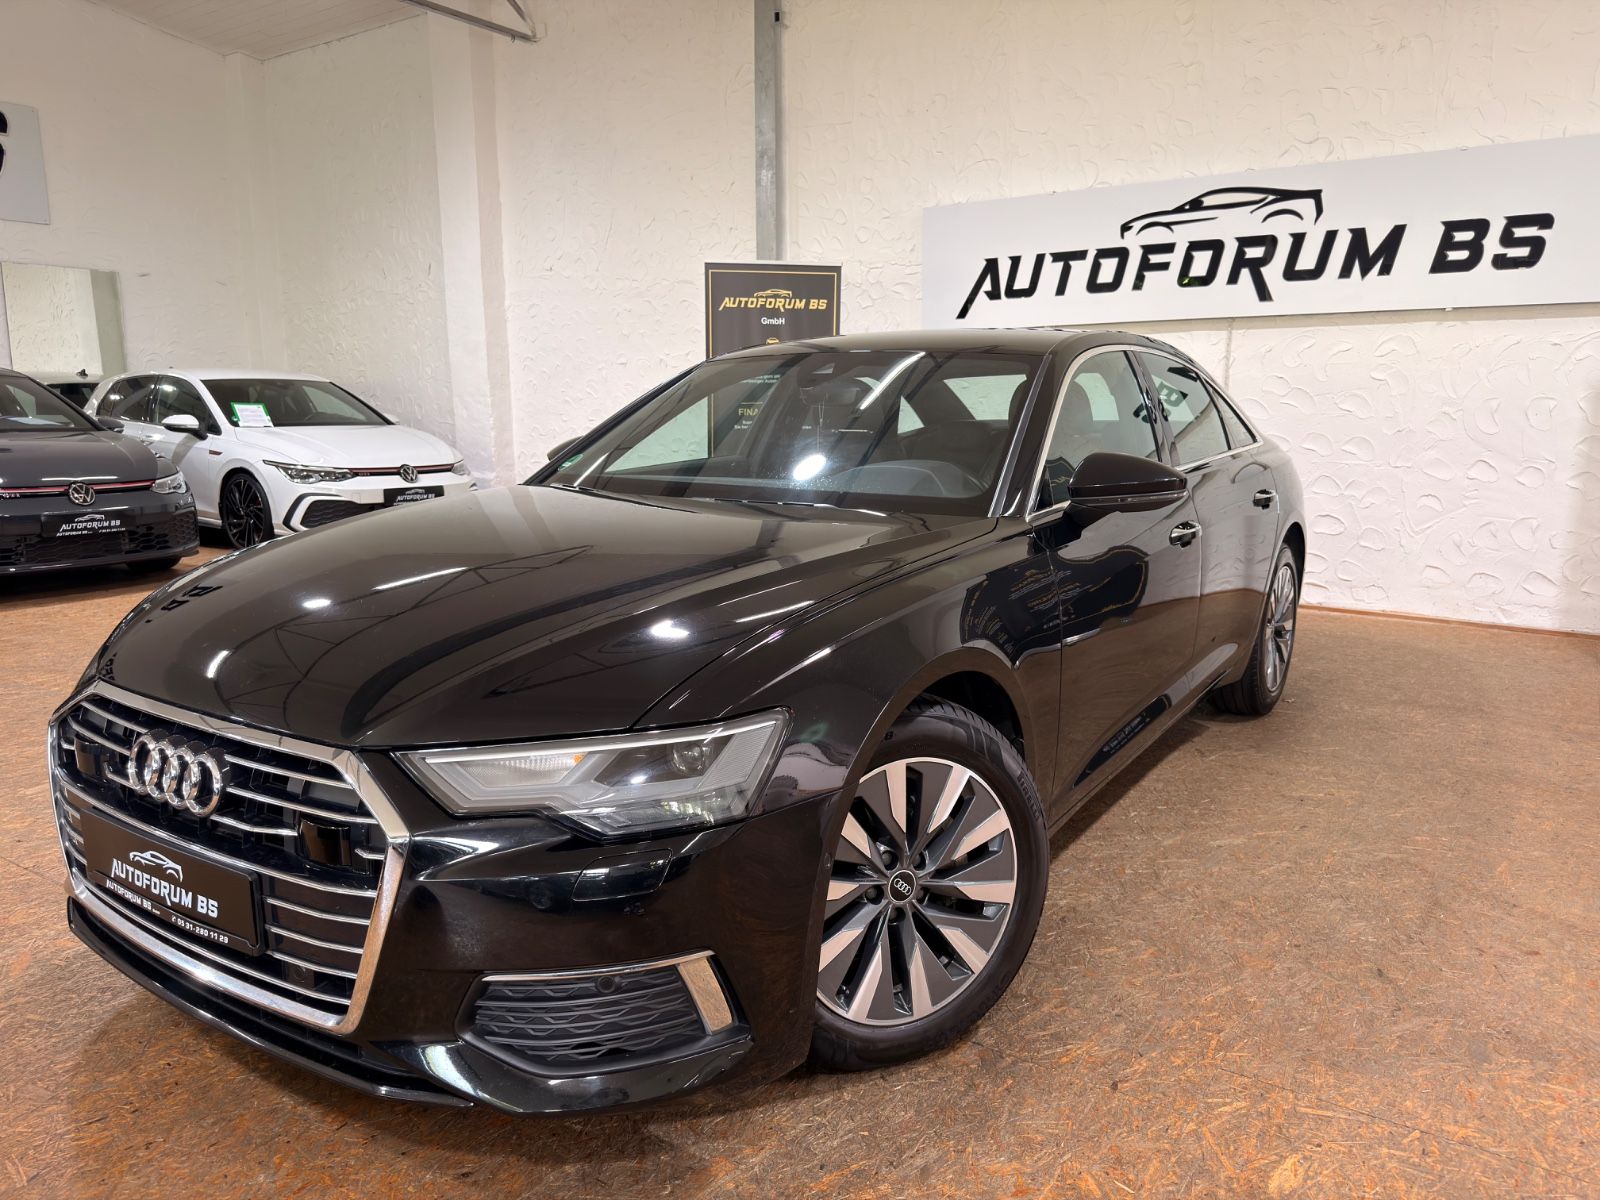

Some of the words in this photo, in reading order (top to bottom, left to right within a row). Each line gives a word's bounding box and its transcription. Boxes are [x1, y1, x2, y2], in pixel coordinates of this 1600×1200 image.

[956, 223, 1407, 319] AUTOFORUM
[1428, 212, 1556, 274] BS
[719, 297, 805, 312] AUTOFORUM
[809, 299, 828, 310] BS
[761, 317, 785, 325] GmbH
[60, 521, 109, 532] AUTOFORUM
[106, 879, 141, 905] AUTOFORUM
[142, 898, 152, 911] BS
[111, 858, 193, 907] AUTOFORUM
[197, 894, 219, 918] BS
[210, 931, 218, 940] 11
[219, 934, 229, 944] 29
